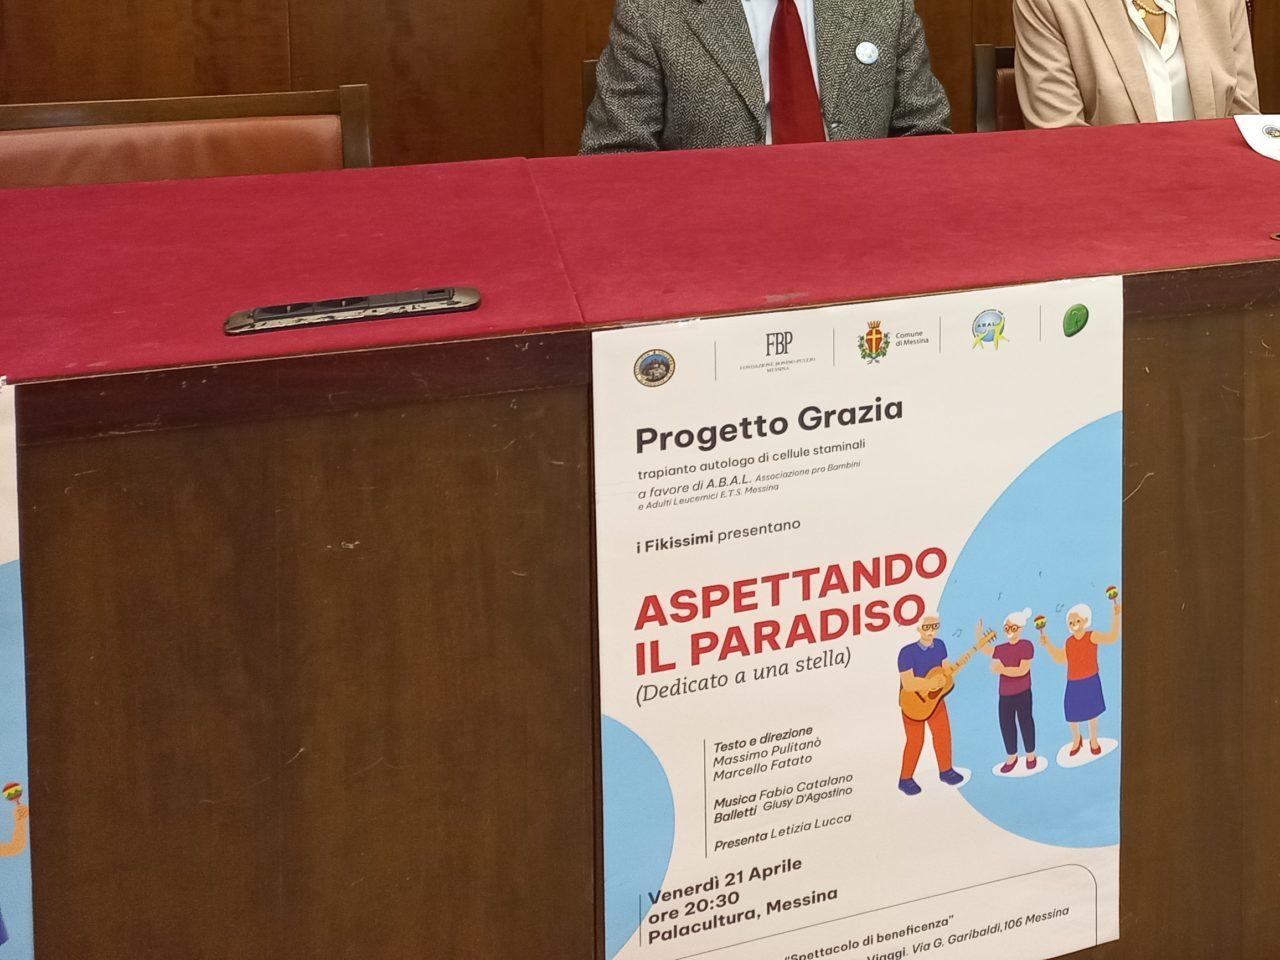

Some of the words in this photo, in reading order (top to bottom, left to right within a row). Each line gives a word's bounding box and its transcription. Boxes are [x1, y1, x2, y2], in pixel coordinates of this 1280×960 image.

[765, 331, 793, 356] FBP
[895, 330, 923, 339] Comune
[903, 337, 930, 347] Messina
[636, 414, 788, 454] Progetto
[798, 396, 903, 432] Grazia
[638, 464, 696, 480] trapianto
[700, 455, 755, 471] autologo
[758, 451, 769, 464] di
[772, 447, 810, 462] cellule
[813, 439, 866, 456] staminali
[638, 490, 647, 500] a
[649, 484, 690, 498] favore
[692, 480, 704, 492] di
[706, 474, 752, 489] A.B.A.L.
[755, 467, 810, 483] Associazione
[811, 464, 826, 476] pro
[827, 460, 861, 472] Bambini
[646, 500, 671, 510] Adulti
[673, 493, 719, 506] Leucemici
[745, 483, 780, 495] Messina
[636, 542, 642, 554] i
[645, 531, 714, 553] Fikissimi
[717, 519, 801, 544] presentano
[634, 547, 947, 631] ASPETTANDO
[636, 640, 676, 676] IL
[690, 594, 926, 666] PARADISO
[636, 672, 729, 708] (Dedicato
[734, 669, 747, 684] a
[753, 660, 789, 681] una
[795, 646, 852, 673] stella)
[713, 749, 769, 767] Massimo
[771, 737, 822, 756] Pulitanò
[714, 739, 747, 754] Testo
[749, 737, 757, 746] e
[759, 726, 813, 744] direzione
[713, 763, 768, 782] Marcello
[770, 754, 813, 770] Fatato
[714, 793, 757, 810] Musica
[759, 786, 794, 800] Fabio
[796, 774, 853, 792] Catalano
[714, 805, 758, 824] Balletti
[763, 798, 793, 811] Giusy
[796, 786, 853, 804] D'Agostino
[714, 832, 768, 852] Presenta
[770, 821, 812, 839] Letizia
[814, 814, 852, 829] Lucca
[648, 876, 720, 905] Venerdì
[724, 870, 744, 887] 21
[748, 858, 802, 881] Aprile
[648, 908, 679, 924] ore
[684, 891, 740, 916] 20:30
[648, 908, 761, 945] Palacultura,
[766, 889, 838, 915] Messina
[862, 934, 874, 947] di
[912, 942, 931, 956] Via
[933, 937, 944, 949] G.
[1025, 906, 1070, 925] Messina
